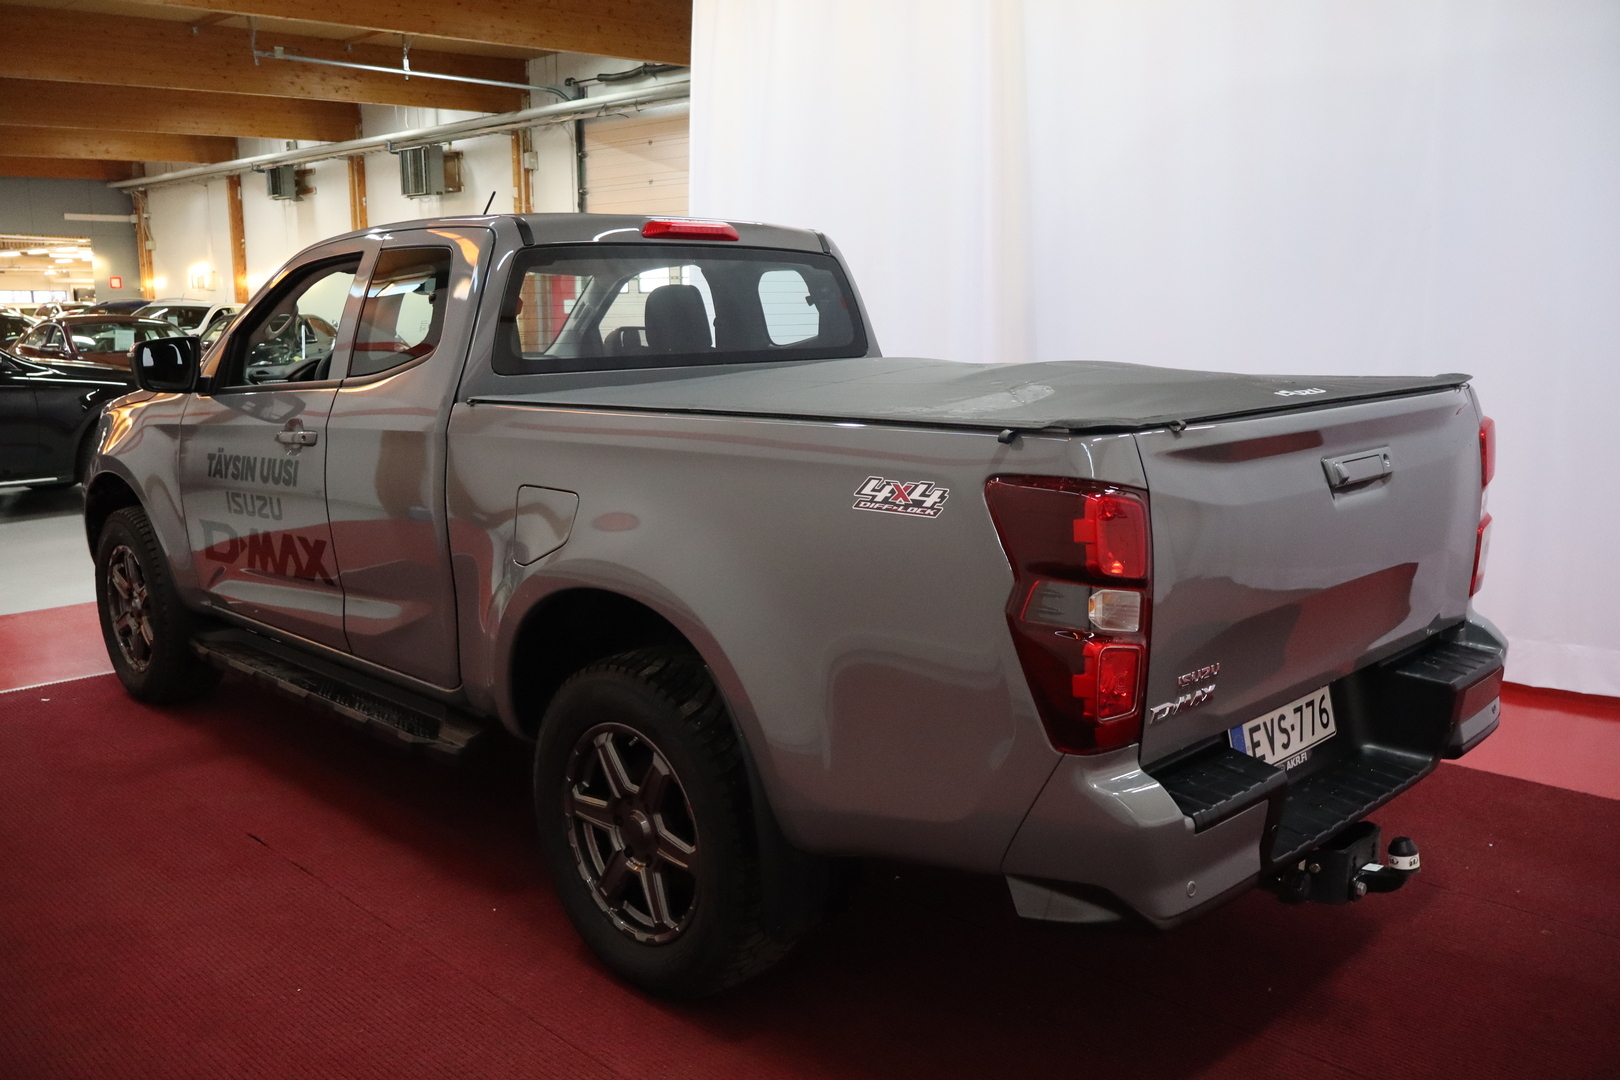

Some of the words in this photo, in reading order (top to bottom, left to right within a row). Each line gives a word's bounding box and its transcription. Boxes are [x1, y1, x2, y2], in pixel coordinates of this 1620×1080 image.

[207, 447, 257, 482] TÄYSIN
[260, 457, 300, 487] UUSI
[226, 491, 283, 521] ISUZU
[1177, 662, 1221, 687] ISUZU
[1248, 694, 1330, 763] EVS-776
